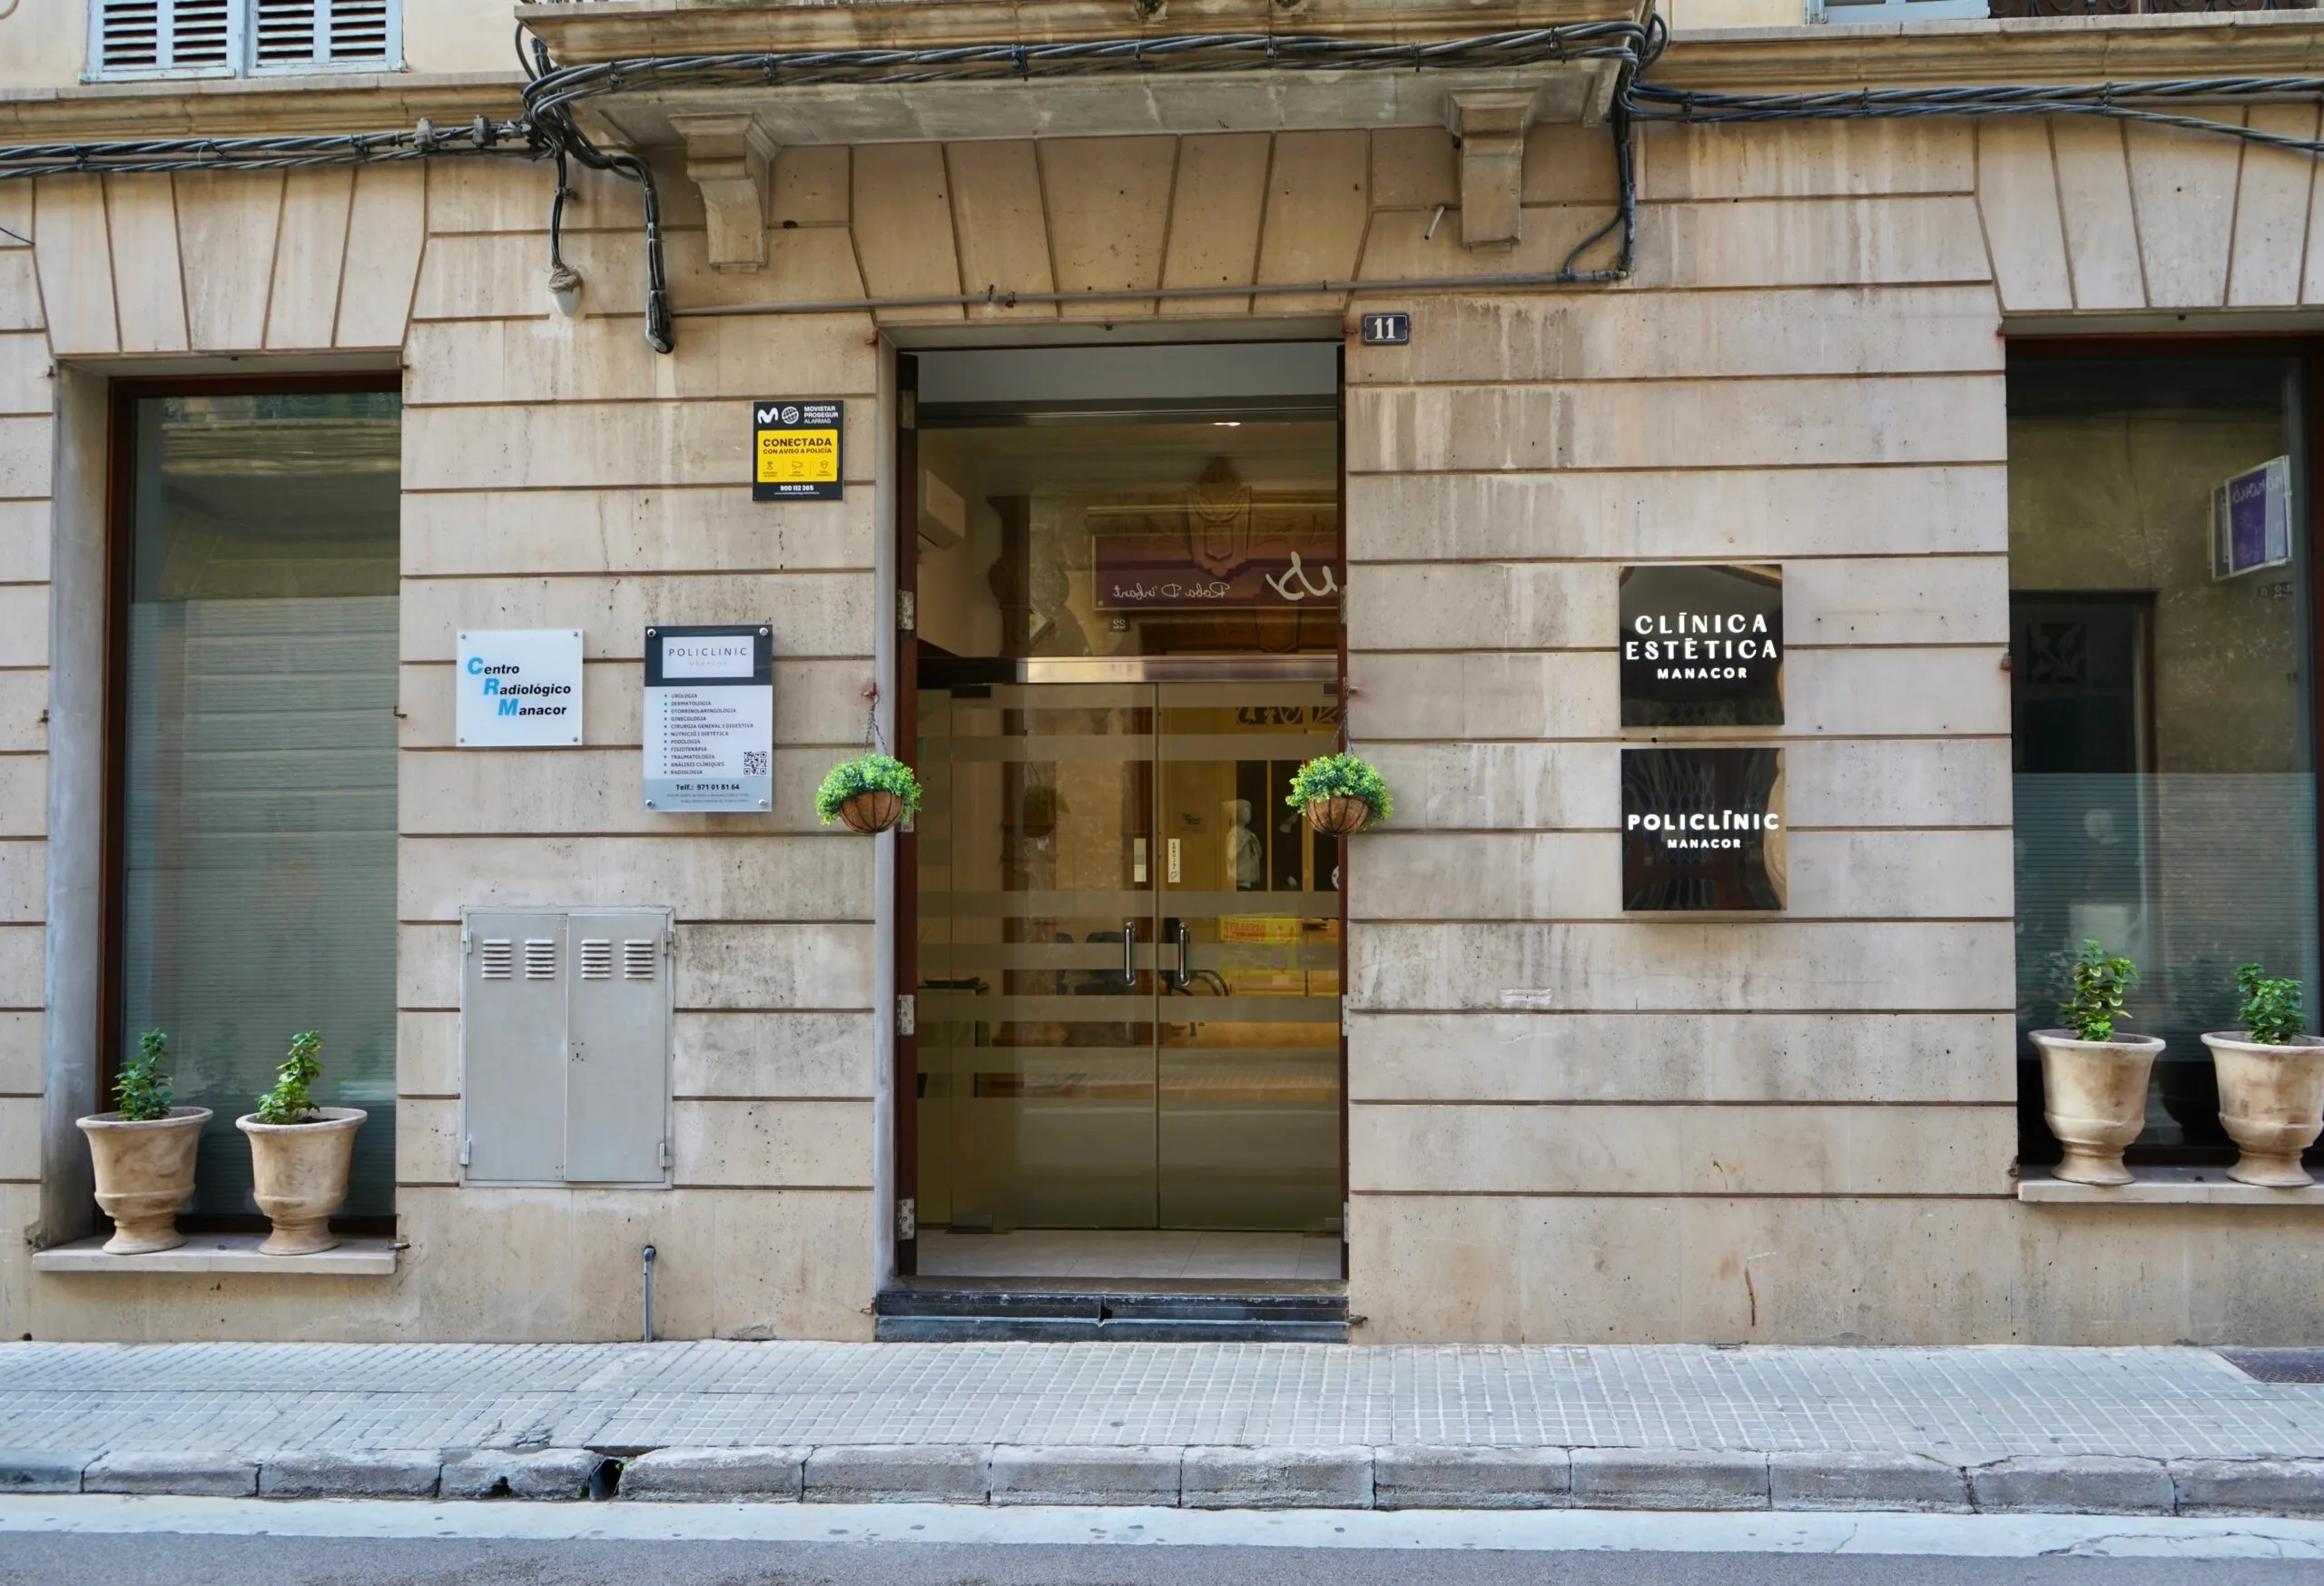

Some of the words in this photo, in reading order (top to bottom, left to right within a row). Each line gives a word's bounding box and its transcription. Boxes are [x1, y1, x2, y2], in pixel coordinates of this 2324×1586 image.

[1374, 318, 1395, 339] 11
[763, 438, 832, 447] CONECTADA
[668, 647, 748, 656] POLICLINIC
[468, 657, 520, 675] Centro
[1657, 667, 1748, 679] MANACOR
[483, 677, 572, 697] Radiológico
[497, 698, 567, 716] Manacor
[1667, 839, 1741, 849] MANACOR
